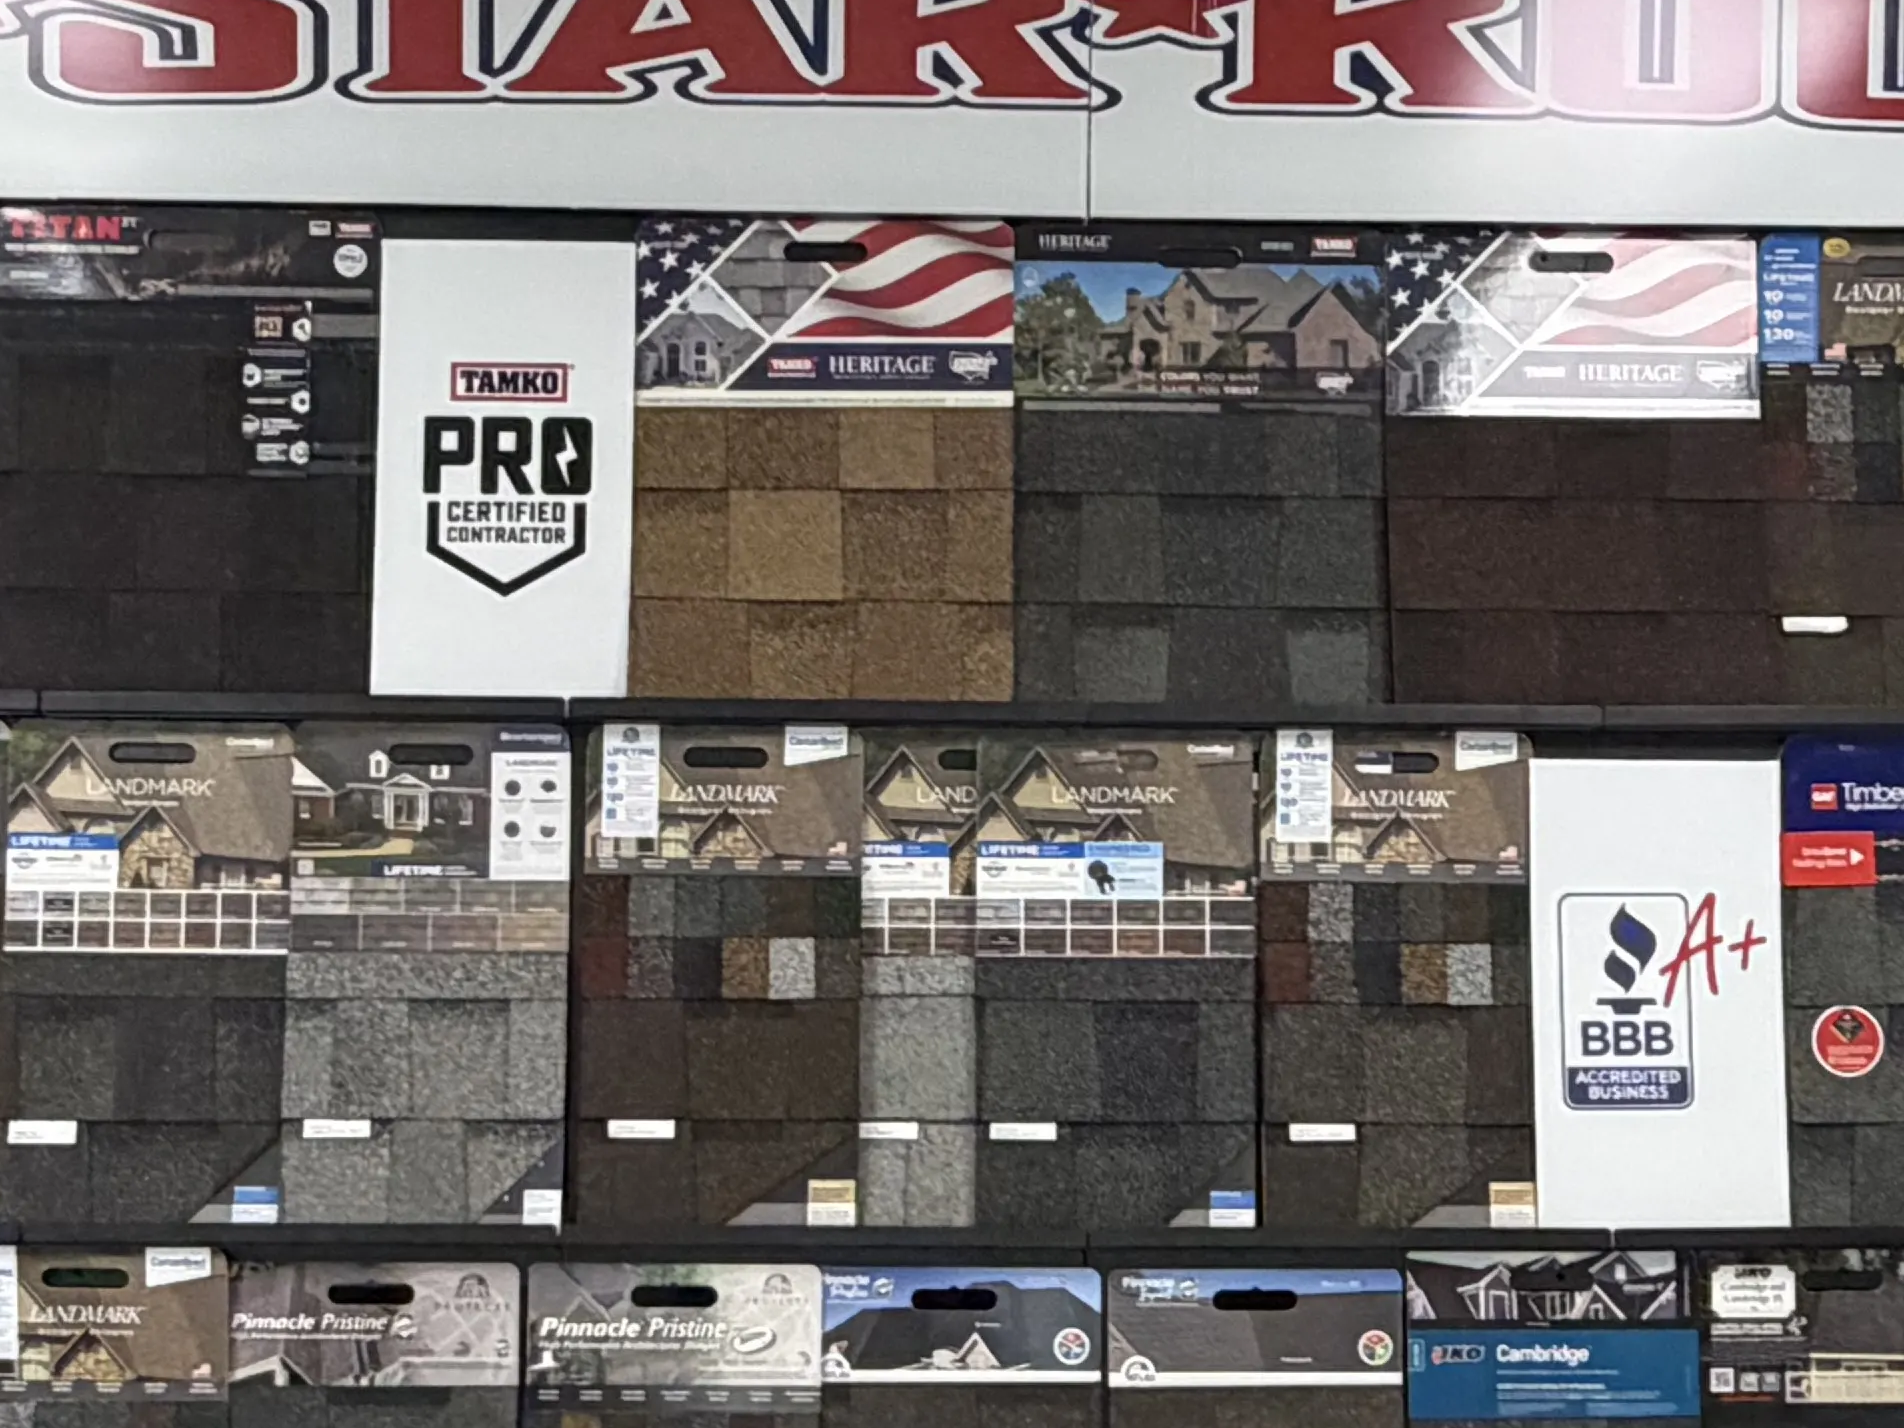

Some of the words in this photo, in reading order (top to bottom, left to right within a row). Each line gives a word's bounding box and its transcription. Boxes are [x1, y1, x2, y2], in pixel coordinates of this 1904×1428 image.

[1038, 233, 1111, 250] HERITAGE
[1763, 328, 1795, 341] 130
[828, 354, 935, 374] HERITAGE
[1577, 363, 1683, 382] HERITAGE
[459, 369, 559, 395] TAMKO
[422, 415, 594, 495] PRO
[446, 500, 566, 523] CERTIFIED
[445, 526, 567, 545] CONTRACTOR
[85, 778, 215, 797] LANDMARK
[669, 783, 779, 804] LANDMARK
[1050, 786, 1173, 804] LANDMARK
[1343, 789, 1450, 808] LANDMARK
[10, 835, 72, 848] LIFETIME
[980, 845, 1039, 857] LIFETIME
[1659, 892, 1767, 1008] A+
[1580, 1020, 1674, 1057] BBB
[1575, 1070, 1682, 1085] ACCREDITED
[1588, 1085, 1670, 1100] BUSINESS
[27, 1304, 141, 1325] LANDMARK
[231, 1312, 315, 1330] Pinnacle
[320, 1313, 388, 1330] Pristine
[539, 1316, 641, 1338] Pinnacle
[647, 1316, 728, 1338] Pristine
[1440, 1346, 1483, 1362] IKO
[1496, 1343, 1590, 1367] Cambridge
